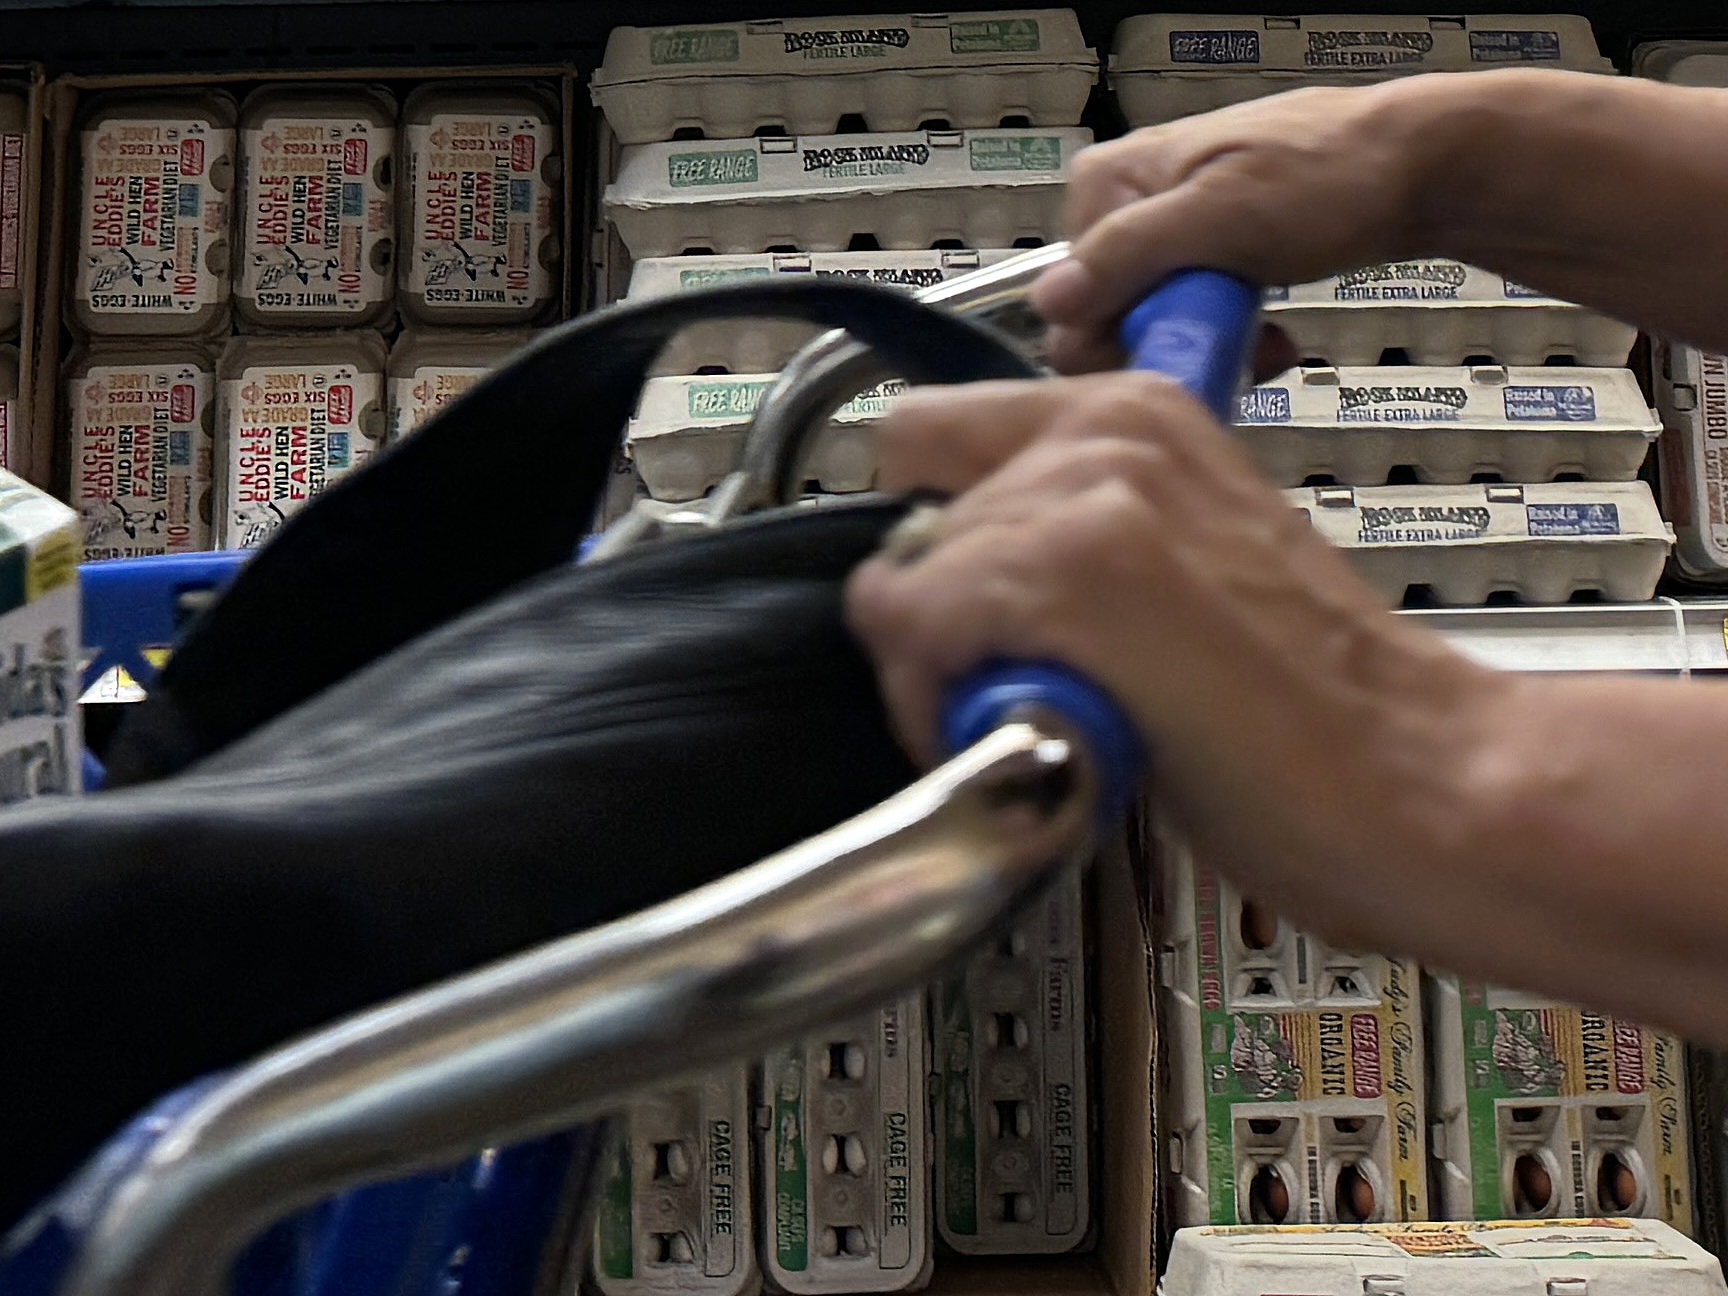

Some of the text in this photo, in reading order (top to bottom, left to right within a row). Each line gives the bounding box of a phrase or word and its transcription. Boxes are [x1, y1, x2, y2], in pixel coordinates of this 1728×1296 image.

[92, 175, 111, 245] UNCLE
[108, 175, 124, 247] EDDIE'S
[126, 175, 142, 245] WILD HEN
[142, 177, 159, 246] FARM
[1705, 381, 1727, 440] JUMBO
[239, 428, 256, 502] UNCLE
[254, 427, 271, 502] EDDIE'S
[275, 426, 289, 501] WILD HEN
[290, 426, 307, 500] FARM
[711, 1120, 733, 1236] CAGE FREE
[885, 1112, 908, 1227] CAGE FREE
